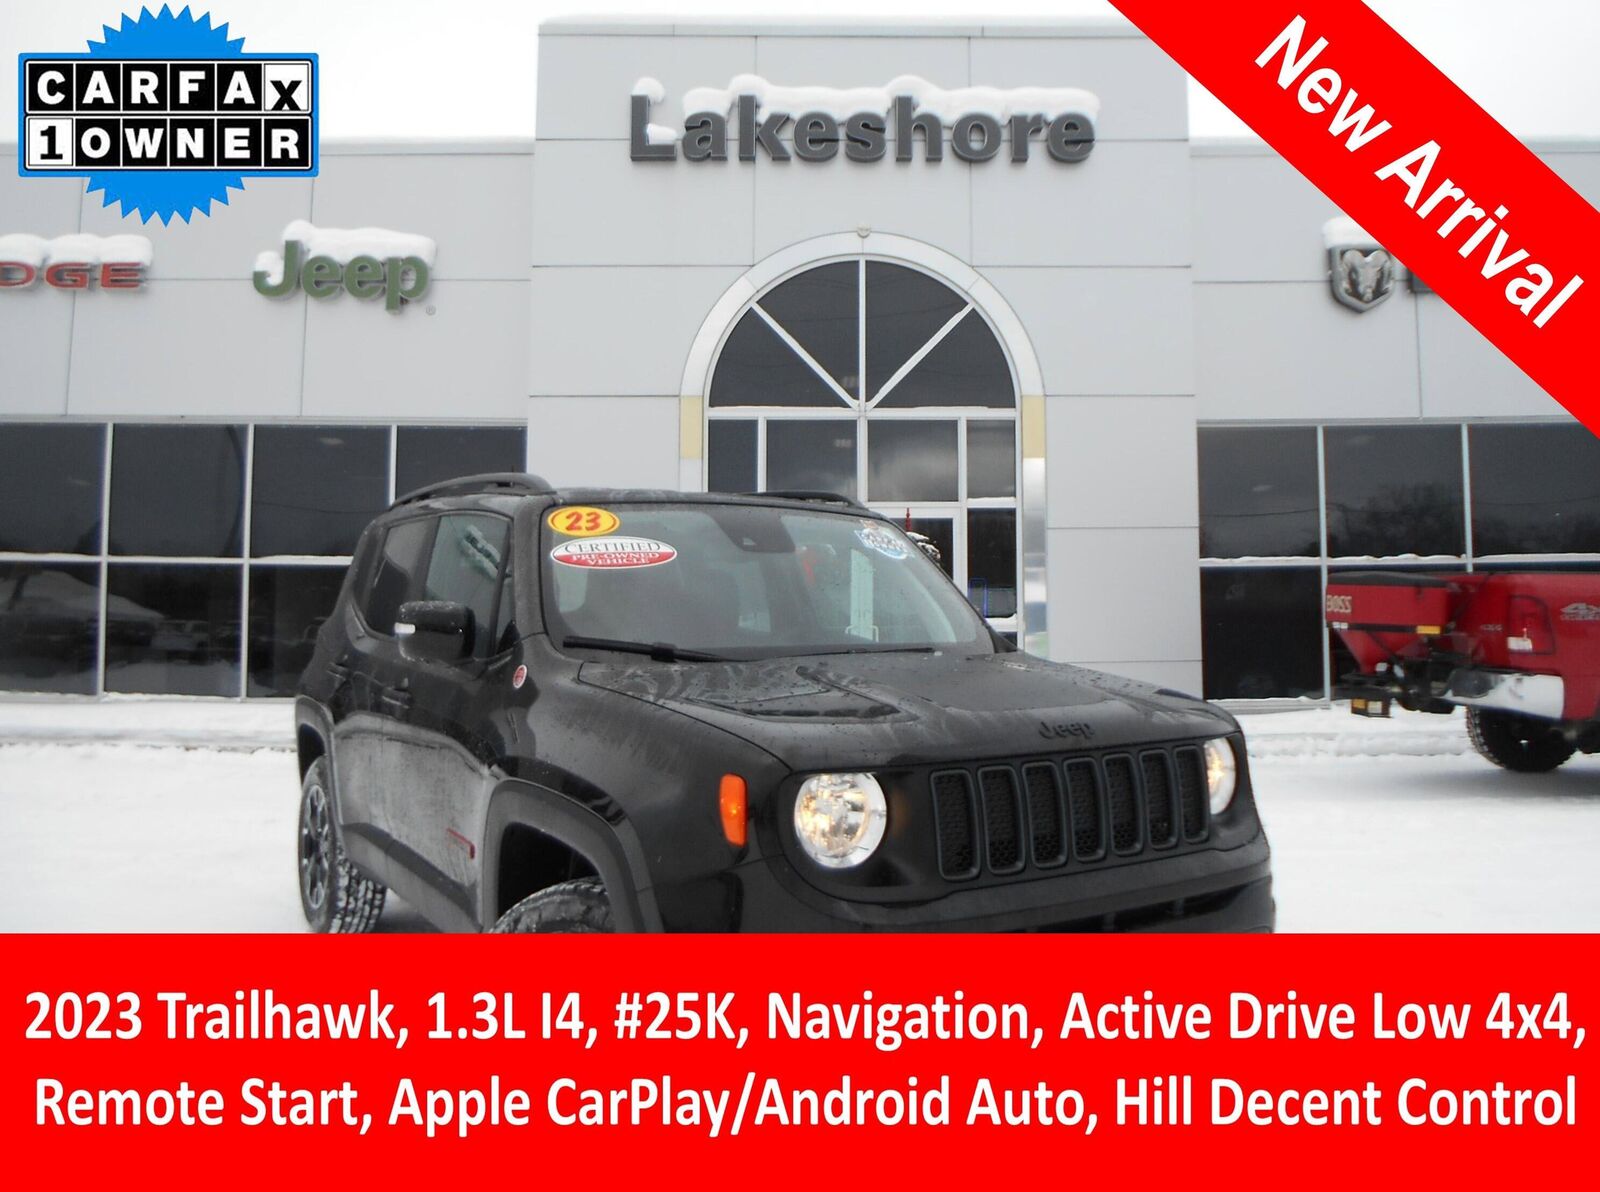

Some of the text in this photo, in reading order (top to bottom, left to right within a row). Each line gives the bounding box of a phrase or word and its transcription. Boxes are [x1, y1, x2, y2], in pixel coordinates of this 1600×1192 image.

[629, 94, 1096, 163] Lakeshore
[252, 240, 430, 312] Jeep
[565, 511, 602, 531] 23
[564, 542, 661, 554] CERTIFIED
[571, 552, 661, 562] PRE-OWNED
